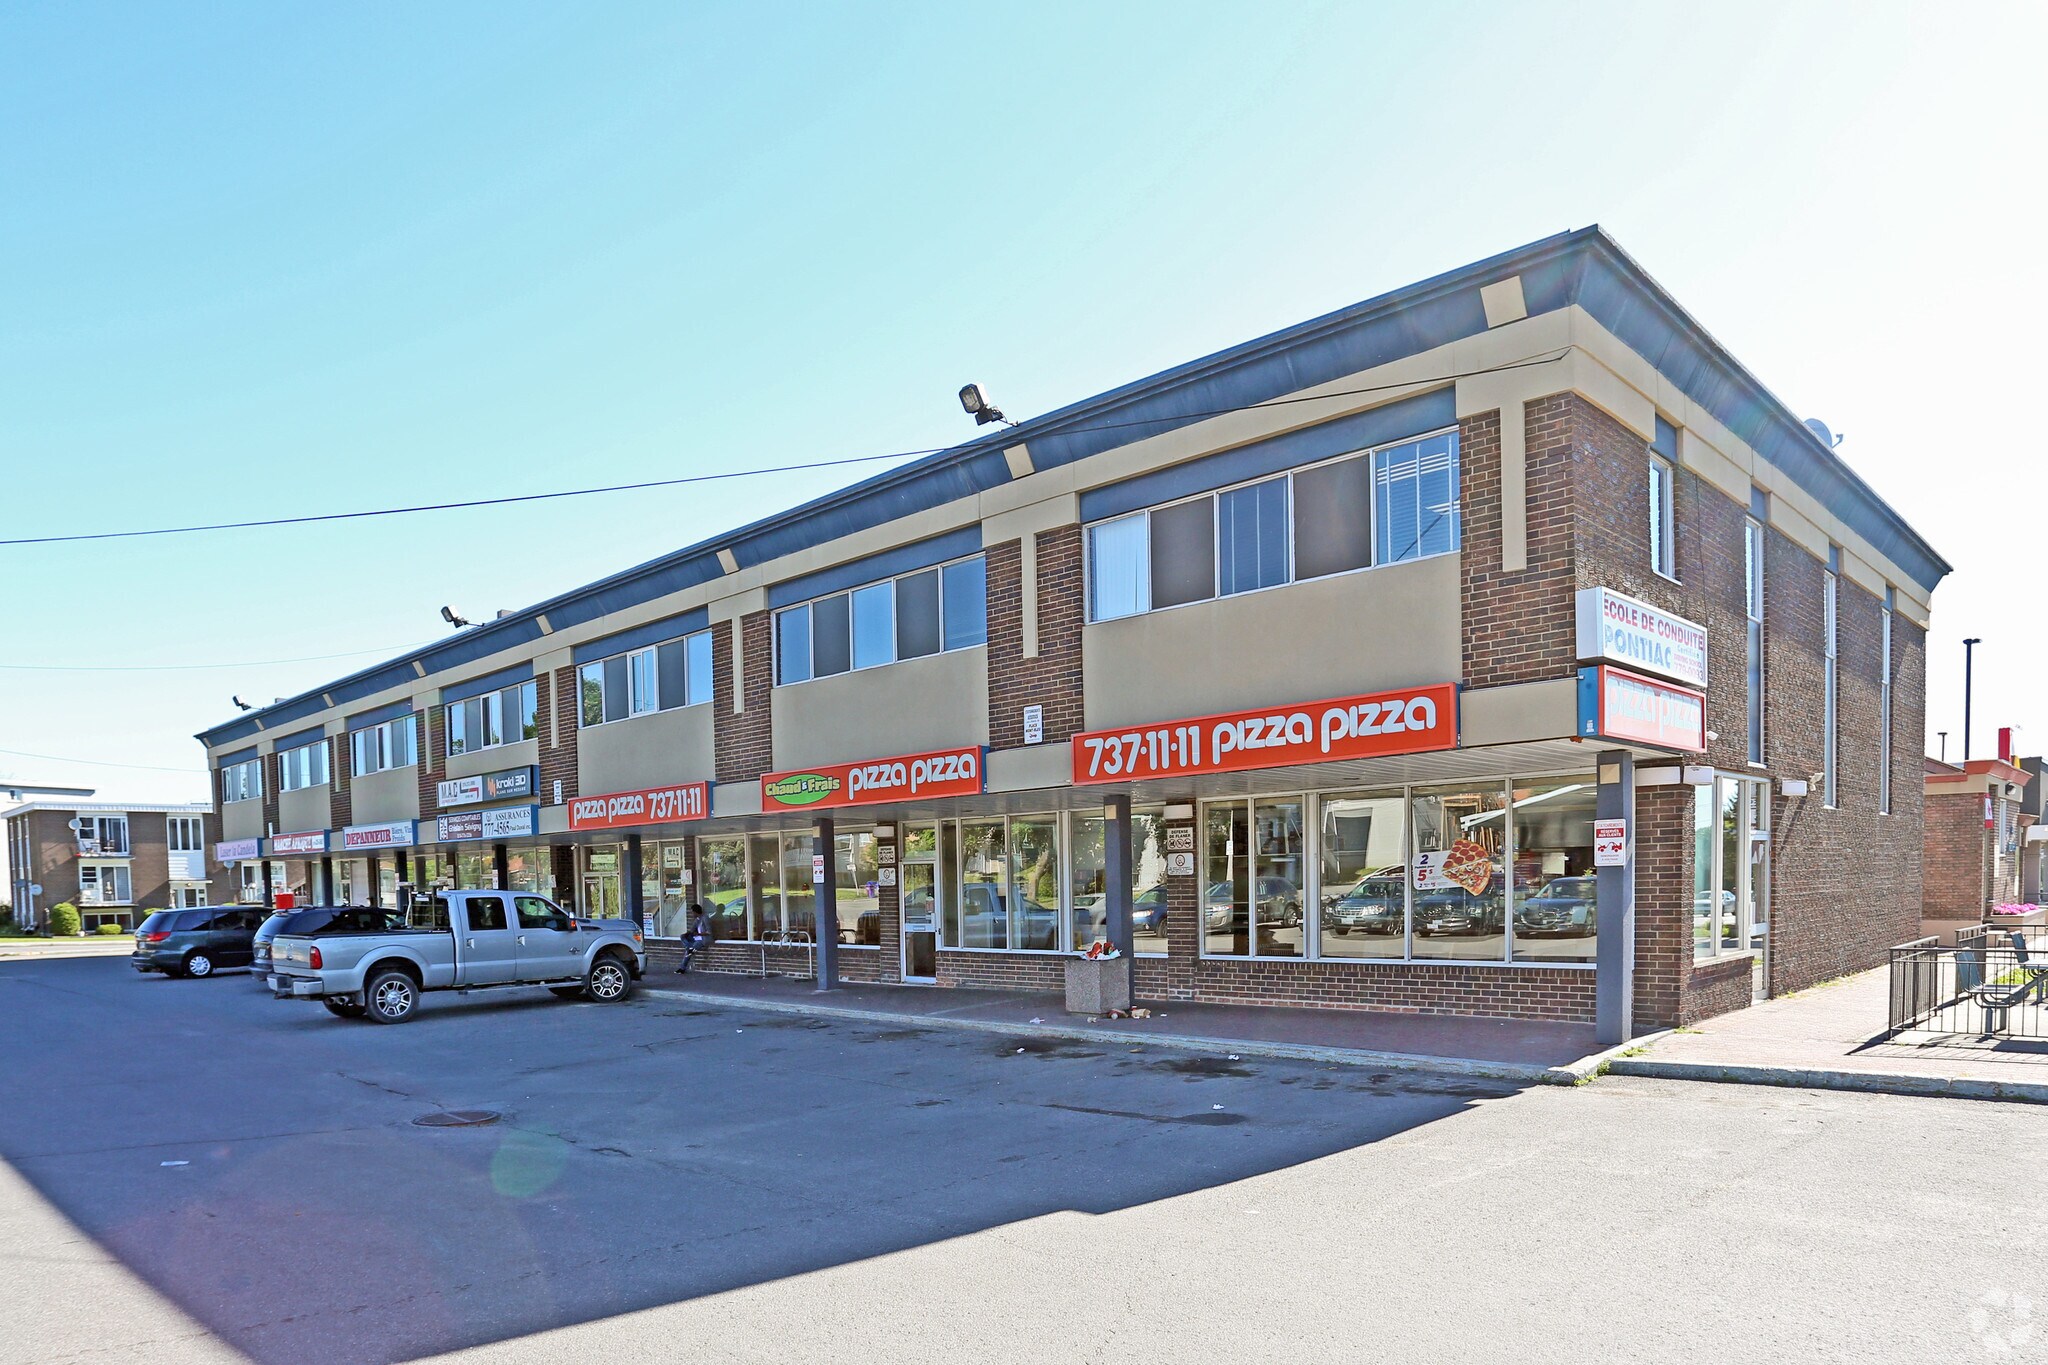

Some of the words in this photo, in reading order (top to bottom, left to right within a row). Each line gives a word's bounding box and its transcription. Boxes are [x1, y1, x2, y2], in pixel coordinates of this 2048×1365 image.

[1604, 624, 1671, 669] PONTIAC
[1641, 612, 1655, 633] DE
[1657, 618, 1704, 651] CONDUITE
[1607, 677, 1656, 729] pizza
[1659, 691, 1701, 739] pizza
[1211, 712, 1313, 765] pizza
[1320, 696, 1436, 753] pizza
[515, 775, 525, 786] 3D
[765, 778, 802, 797] Chaud
[807, 776, 840, 793] Frais
[848, 762, 906, 800] pizza
[910, 753, 976, 794] pizza
[495, 809, 531, 821] ASSURANCES
[573, 799, 606, 826] pizza
[608, 794, 644, 823] pizza
[1417, 869, 1427, 881] 5
[1420, 854, 1429, 865] 2
